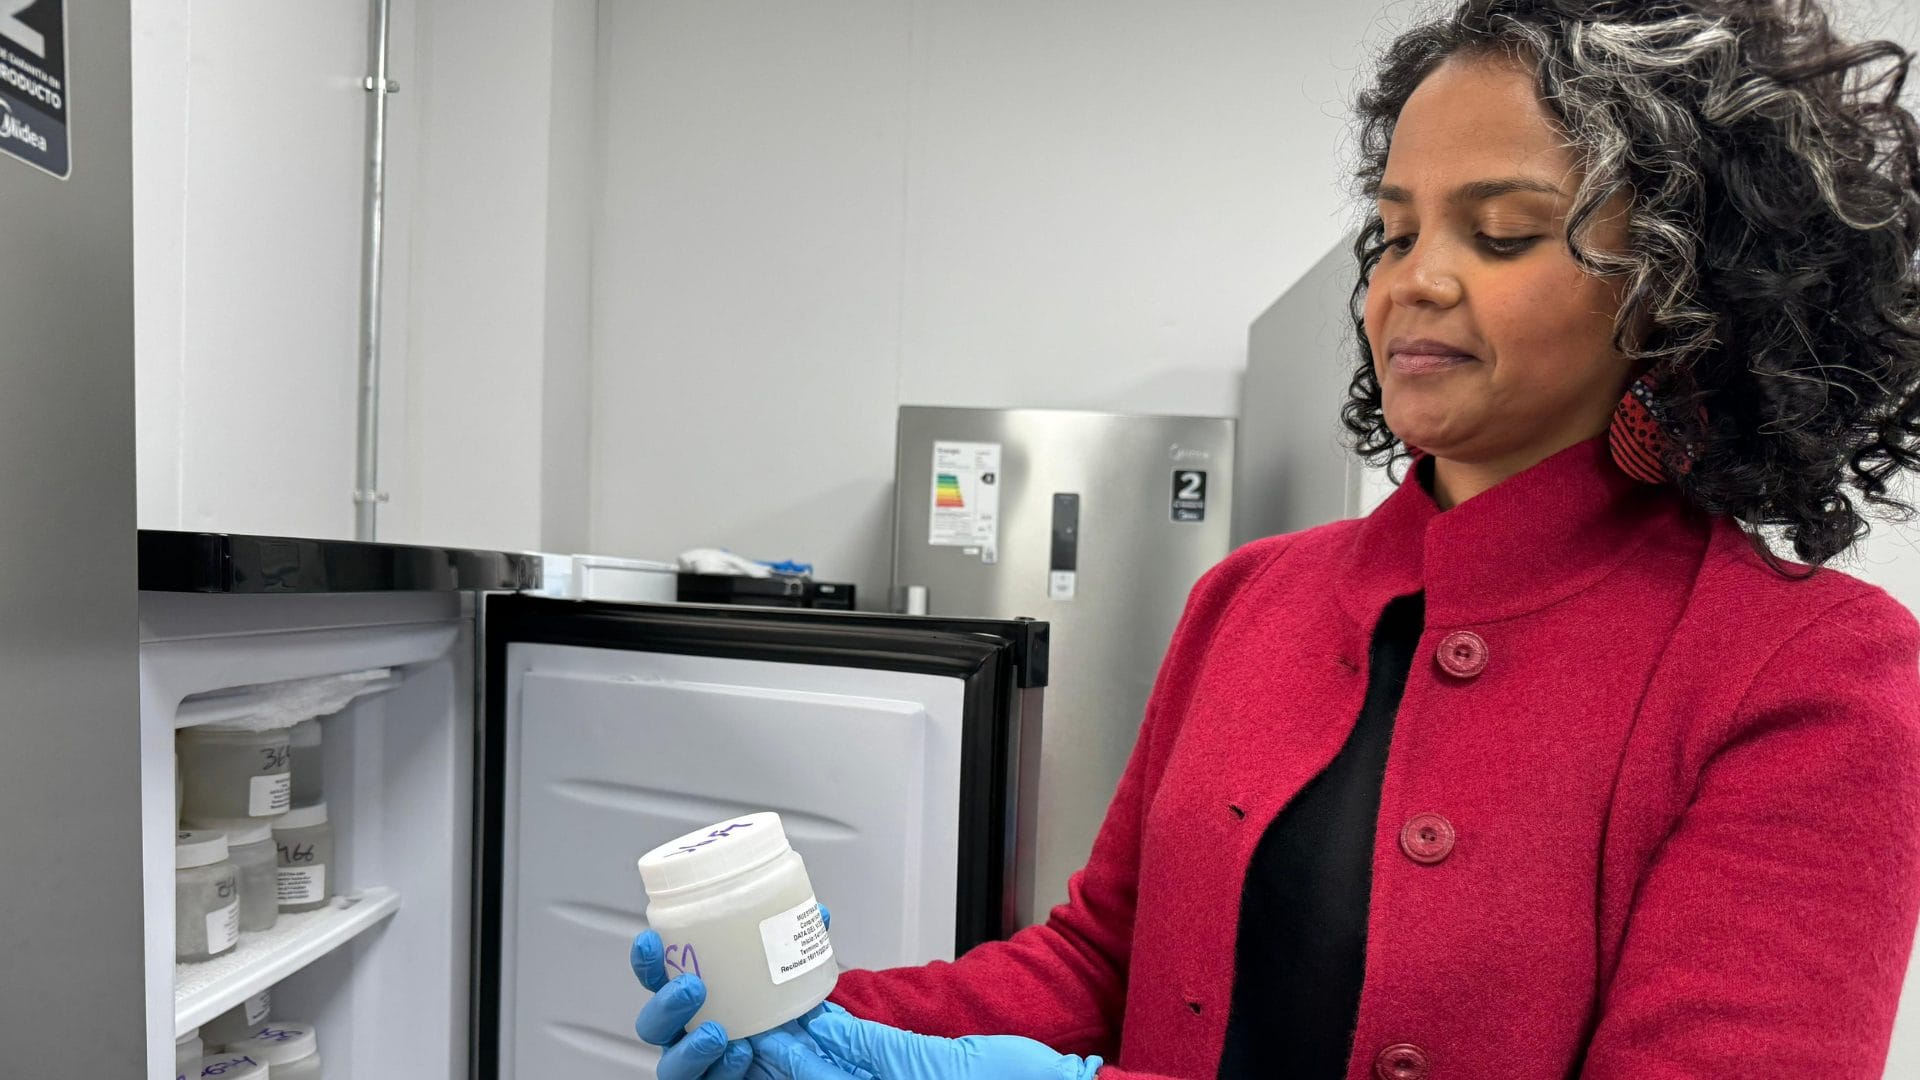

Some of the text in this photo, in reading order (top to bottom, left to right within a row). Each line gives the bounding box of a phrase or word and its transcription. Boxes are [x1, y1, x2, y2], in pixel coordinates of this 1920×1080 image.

[0, 62, 62, 109] RODUCTO
[0, 113, 47, 152] Midea
[1179, 472, 1201, 499] 2
